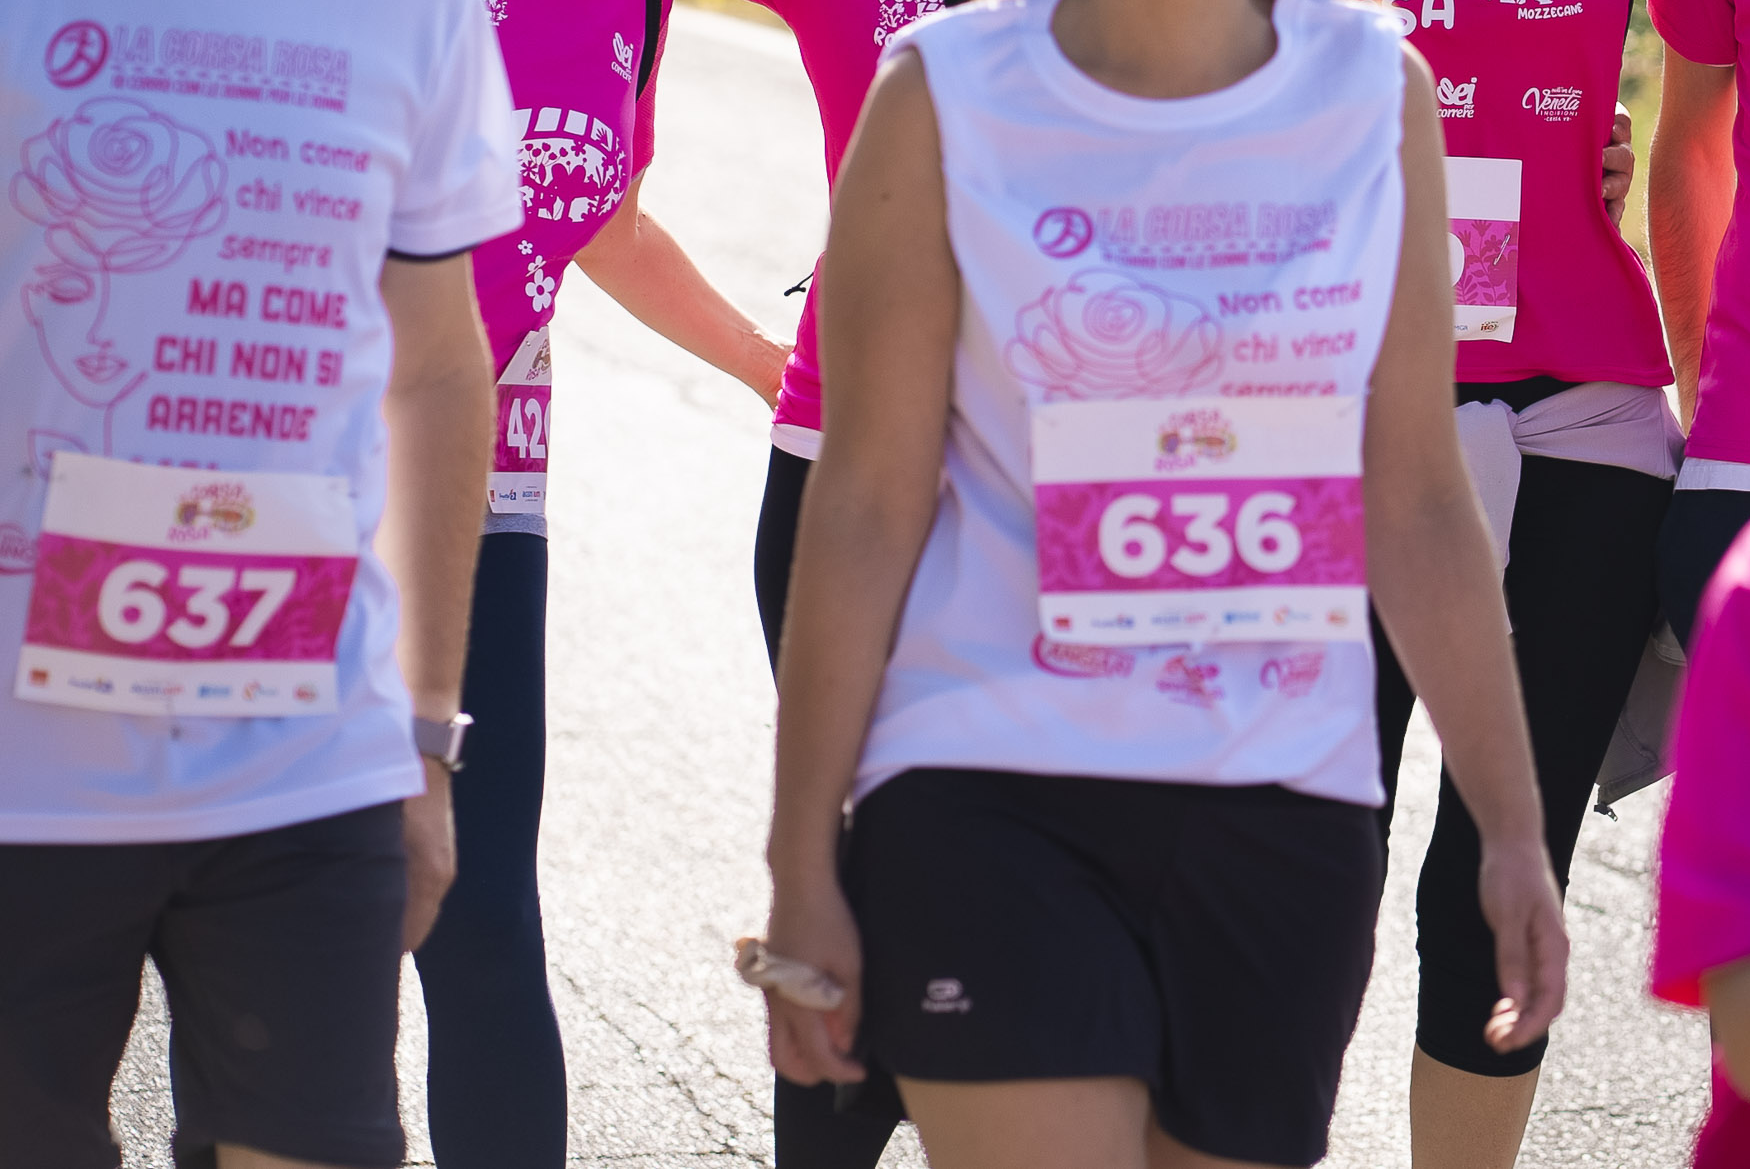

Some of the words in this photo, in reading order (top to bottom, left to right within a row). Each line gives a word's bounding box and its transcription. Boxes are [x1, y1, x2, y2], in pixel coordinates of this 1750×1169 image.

[1517, 2, 1584, 20] MOZZECANE
[1436, 77, 1478, 106] Sei
[1521, 86, 1581, 116] Veneta
[1435, 108, 1475, 119] correre
[225, 128, 290, 162] Non
[300, 139, 372, 174] come
[236, 177, 283, 212] chi
[292, 187, 363, 222] vince
[217, 233, 334, 274] sempre
[186, 277, 248, 319] MA
[259, 284, 348, 330] COME
[1217, 290, 1283, 319] Non
[153, 333, 219, 375] CHI
[229, 340, 308, 385] NON
[314, 349, 344, 387] SI
[1233, 331, 1280, 363] chi
[146, 392, 318, 443] ARRENDE
[1097, 490, 1304, 579] 636
[97, 559, 299, 650] 637
